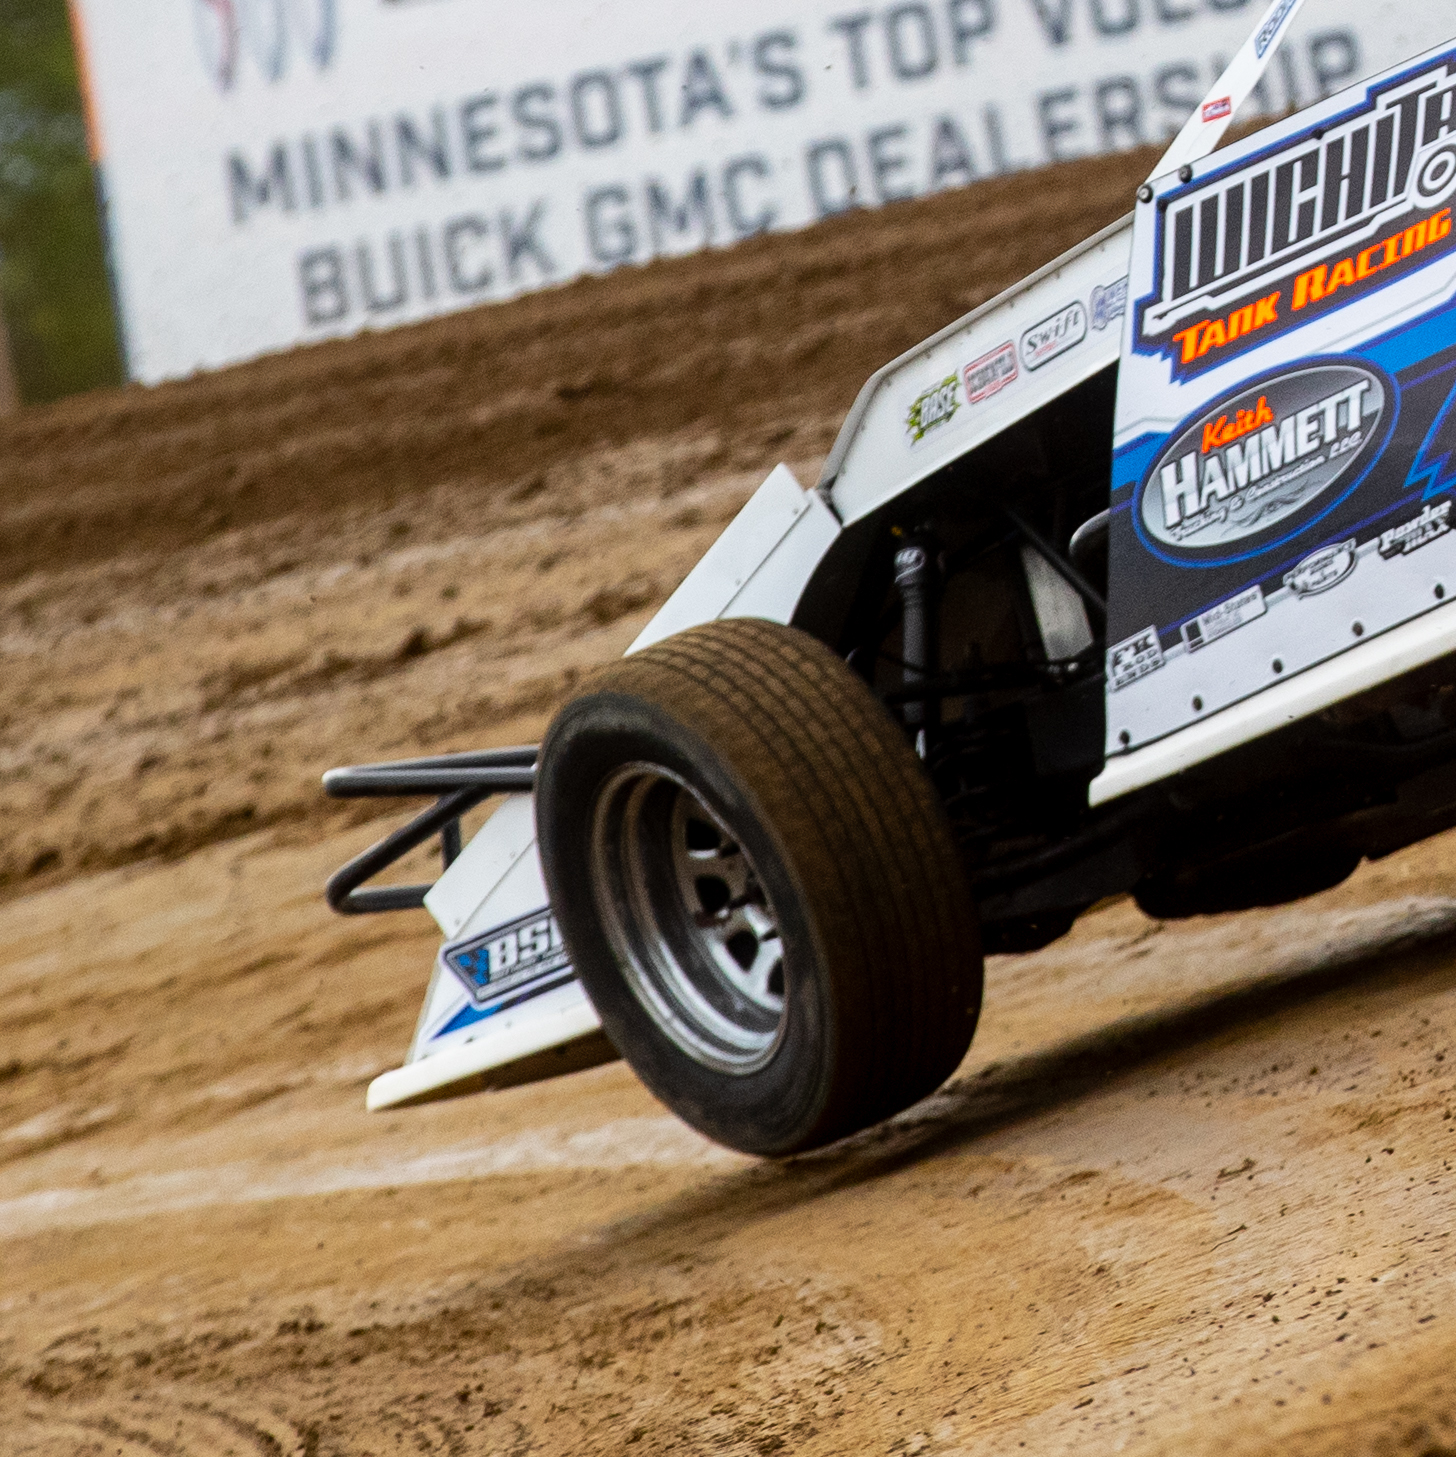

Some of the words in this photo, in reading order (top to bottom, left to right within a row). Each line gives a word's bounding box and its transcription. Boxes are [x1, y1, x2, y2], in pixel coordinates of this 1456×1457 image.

[226, 30, 806, 224] MINNESOTA'S
[298, 198, 558, 327] BUICK
[585, 153, 774, 269] GMC
[1173, 292, 1280, 364] TANK
[1291, 208, 1452, 311] RACING
[1160, 380, 1371, 529] HAMMETT
[1202, 396, 1274, 453] Keith
